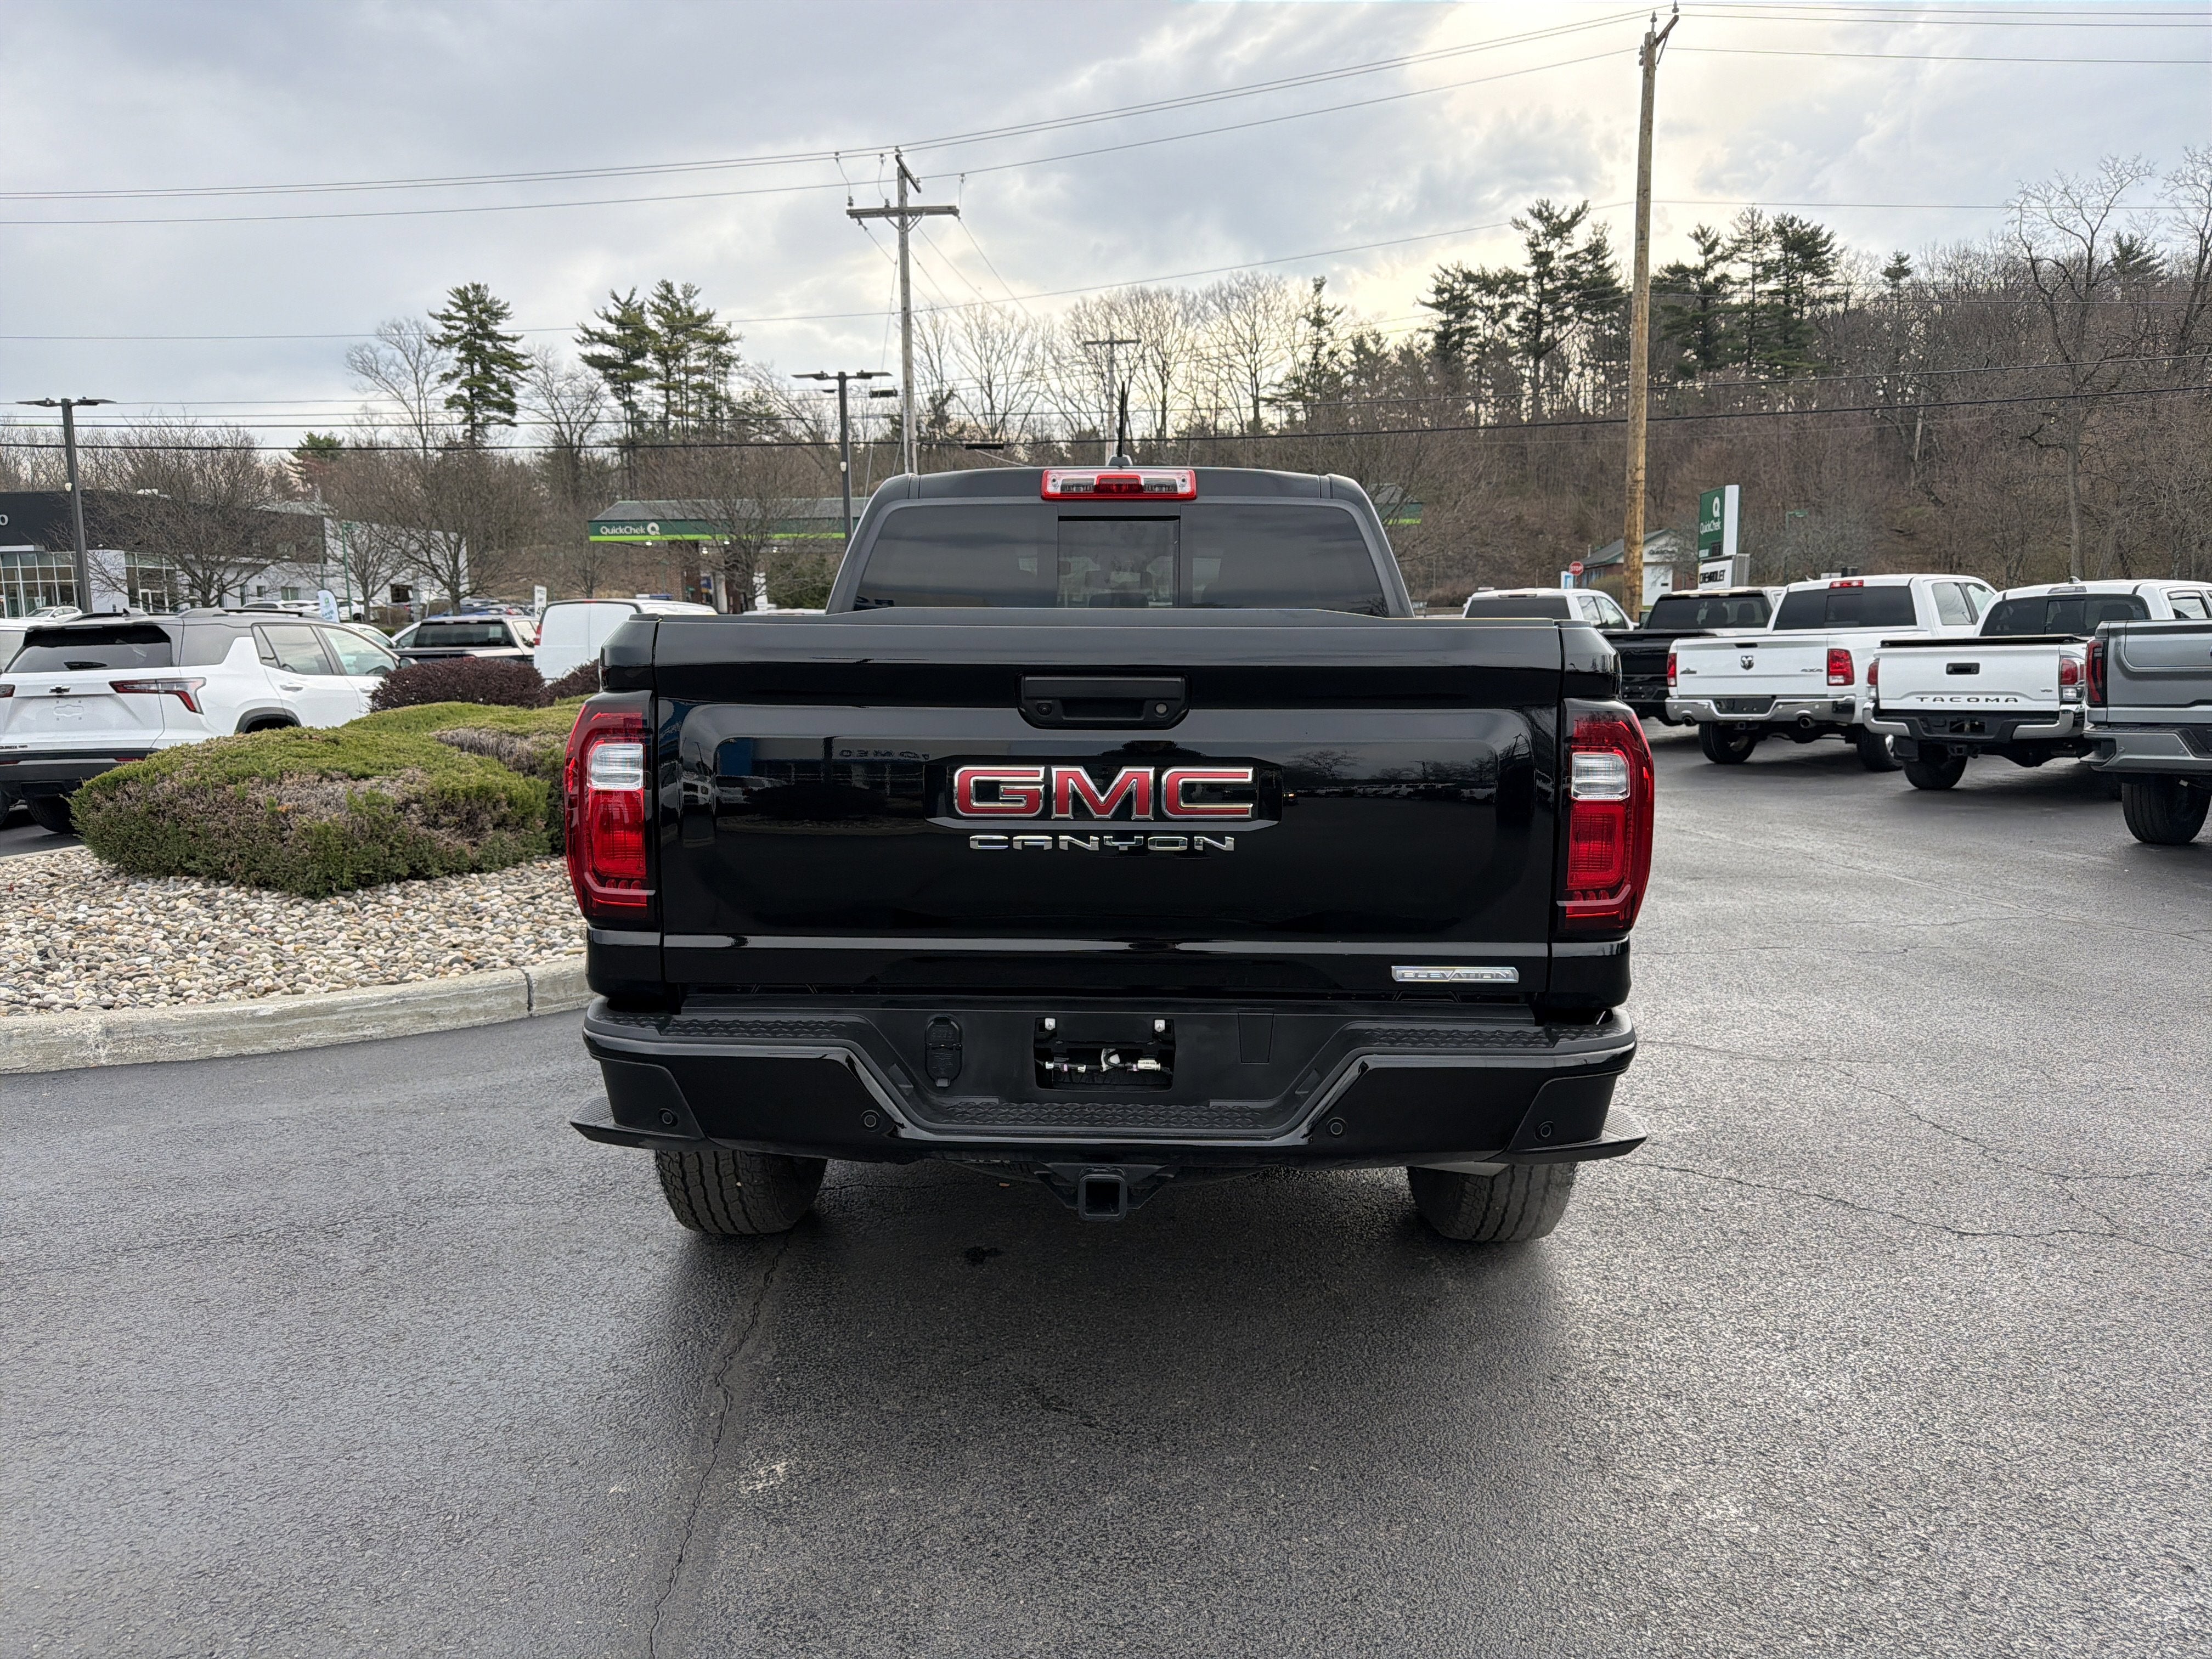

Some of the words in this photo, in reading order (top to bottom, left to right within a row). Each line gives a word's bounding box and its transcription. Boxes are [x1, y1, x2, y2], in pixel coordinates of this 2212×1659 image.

[600, 526, 646, 535] QuickChek
[1700, 518, 1721, 535] QuickChek
[953, 765, 1254, 821] GMC
[969, 835, 1234, 851] CANYON
[1401, 970, 1510, 979] ELEVATION
